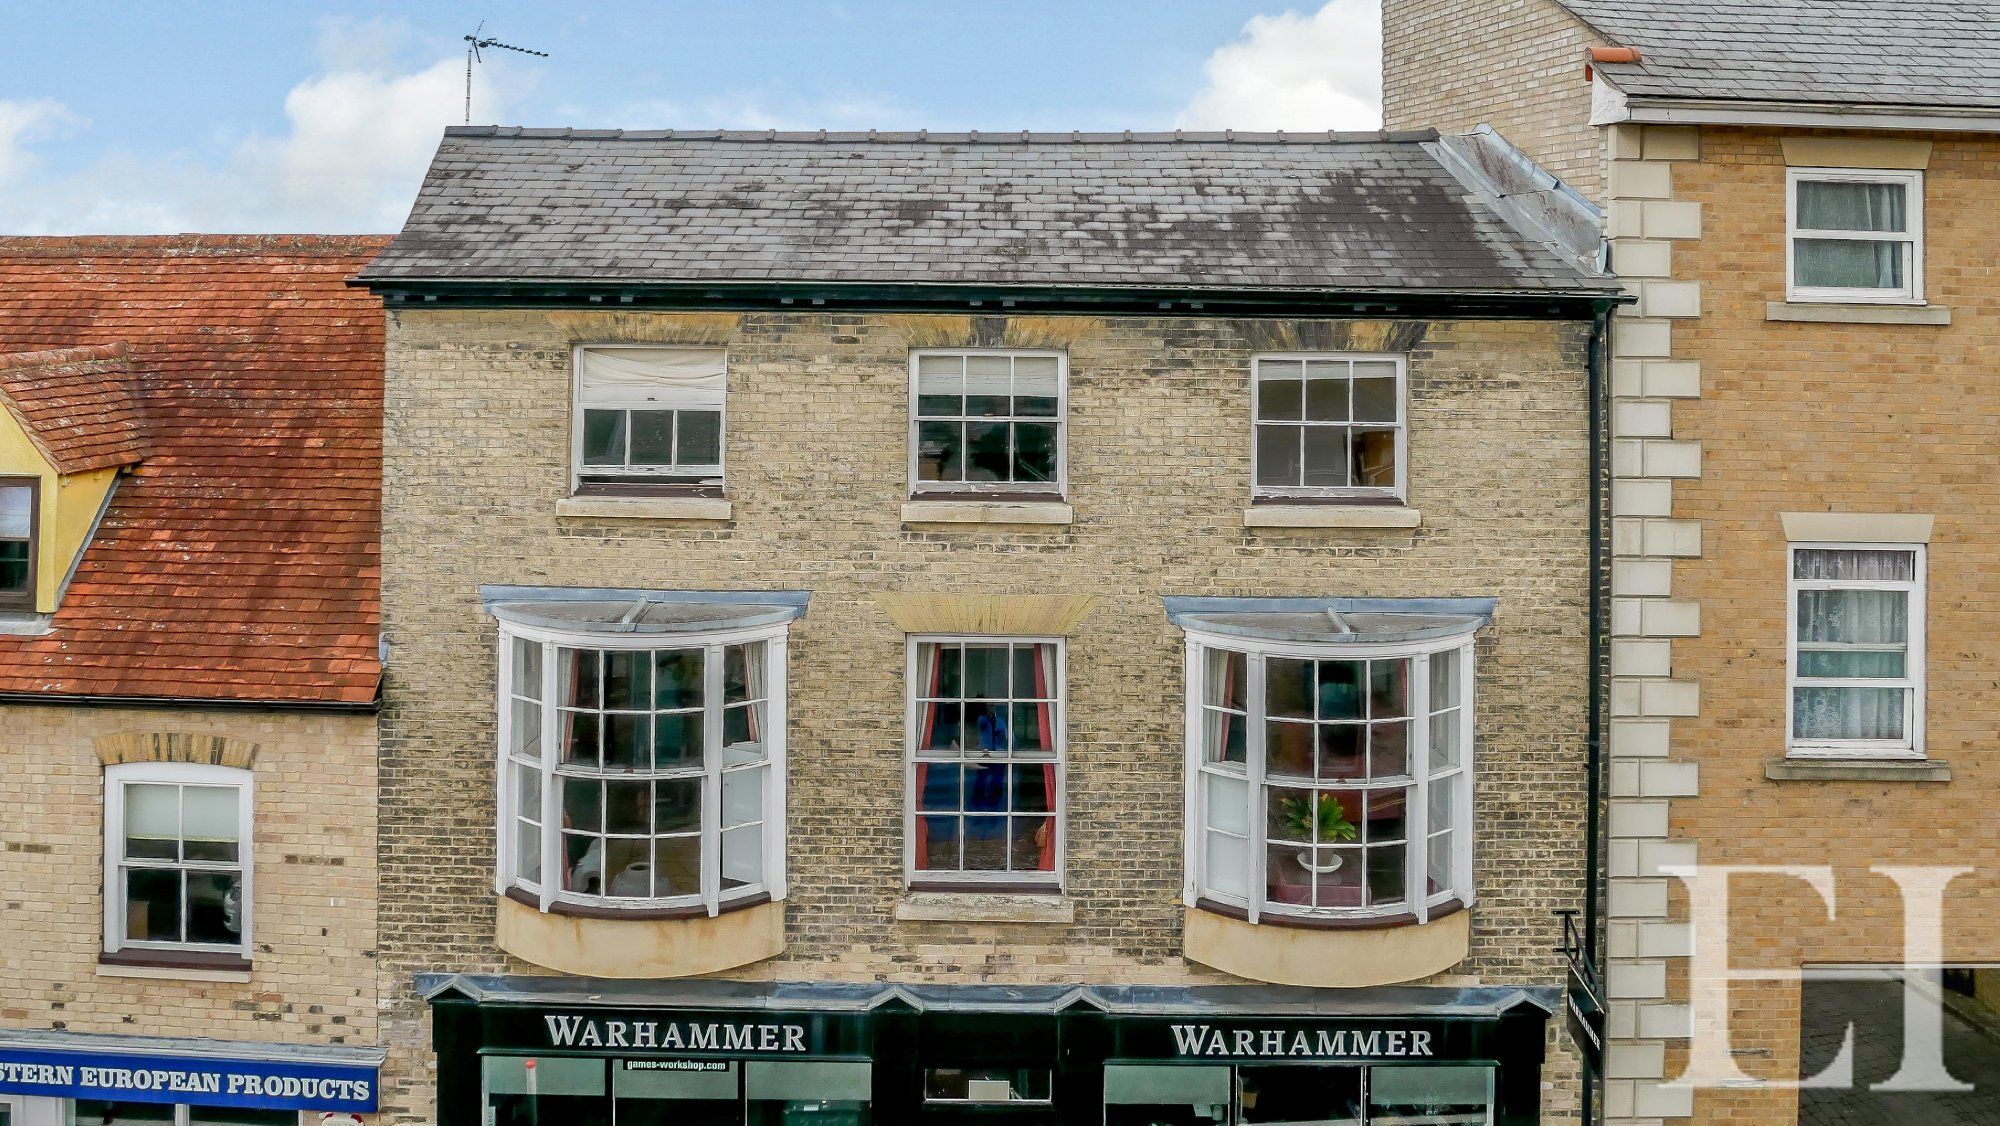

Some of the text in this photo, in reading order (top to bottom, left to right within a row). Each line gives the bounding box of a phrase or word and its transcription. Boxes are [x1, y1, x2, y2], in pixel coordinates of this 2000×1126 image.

[544, 1015, 806, 1051] WARHAMMER
[1171, 1025, 1433, 1056] WARHAMMER
[0, 1062, 370, 1100] TERN EUROPEAN PRODUCTS
[627, 1060, 726, 1071] games-workshop.com
